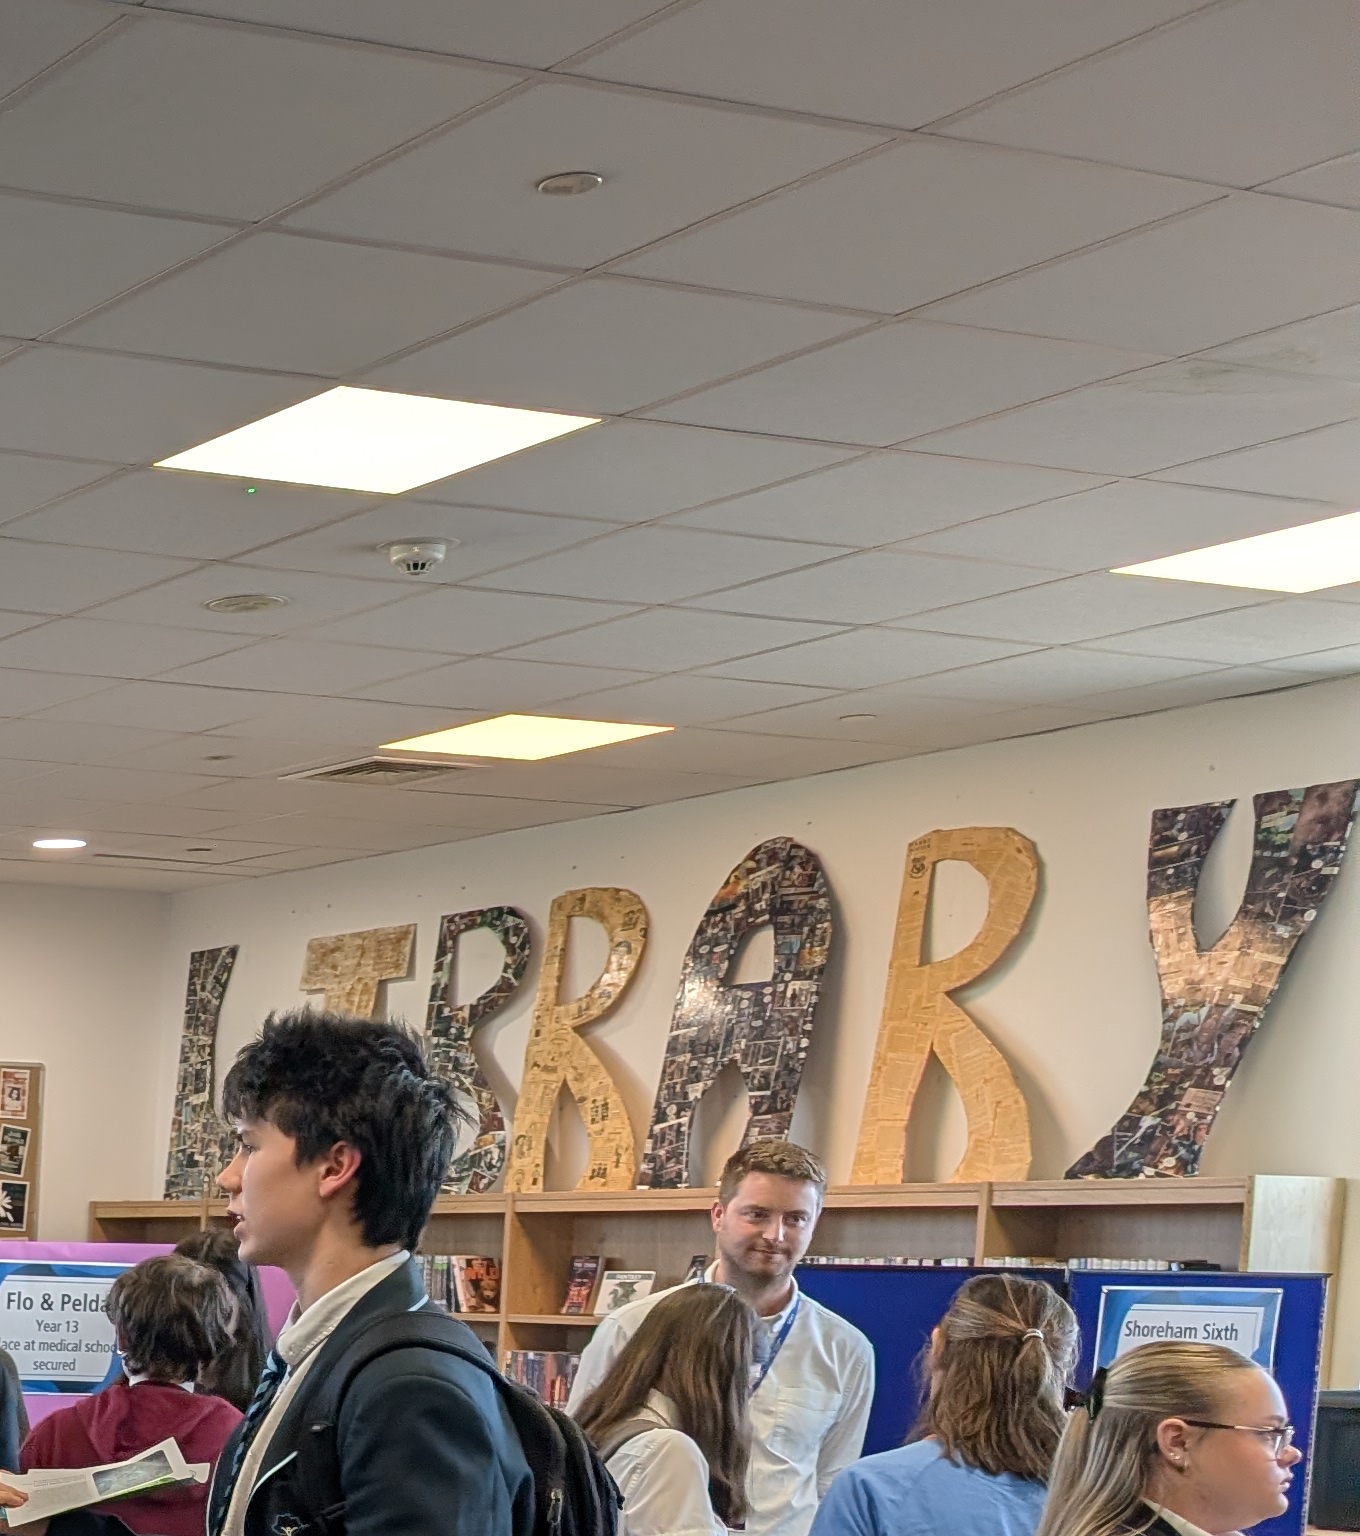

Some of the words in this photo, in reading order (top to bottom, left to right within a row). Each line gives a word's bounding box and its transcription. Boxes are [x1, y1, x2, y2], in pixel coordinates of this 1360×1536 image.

[6, 1291, 34, 1311] Flo
[40, 1292, 55, 1311] &
[35, 1319, 63, 1333] Year
[66, 1320, 79, 1333] 13
[1124, 1320, 1198, 1340] Shoreham
[1202, 1322, 1239, 1342] Sixth
[23, 1339, 36, 1351] at
[38, 1338, 82, 1352] medical
[33, 1358, 76, 1371] secured
